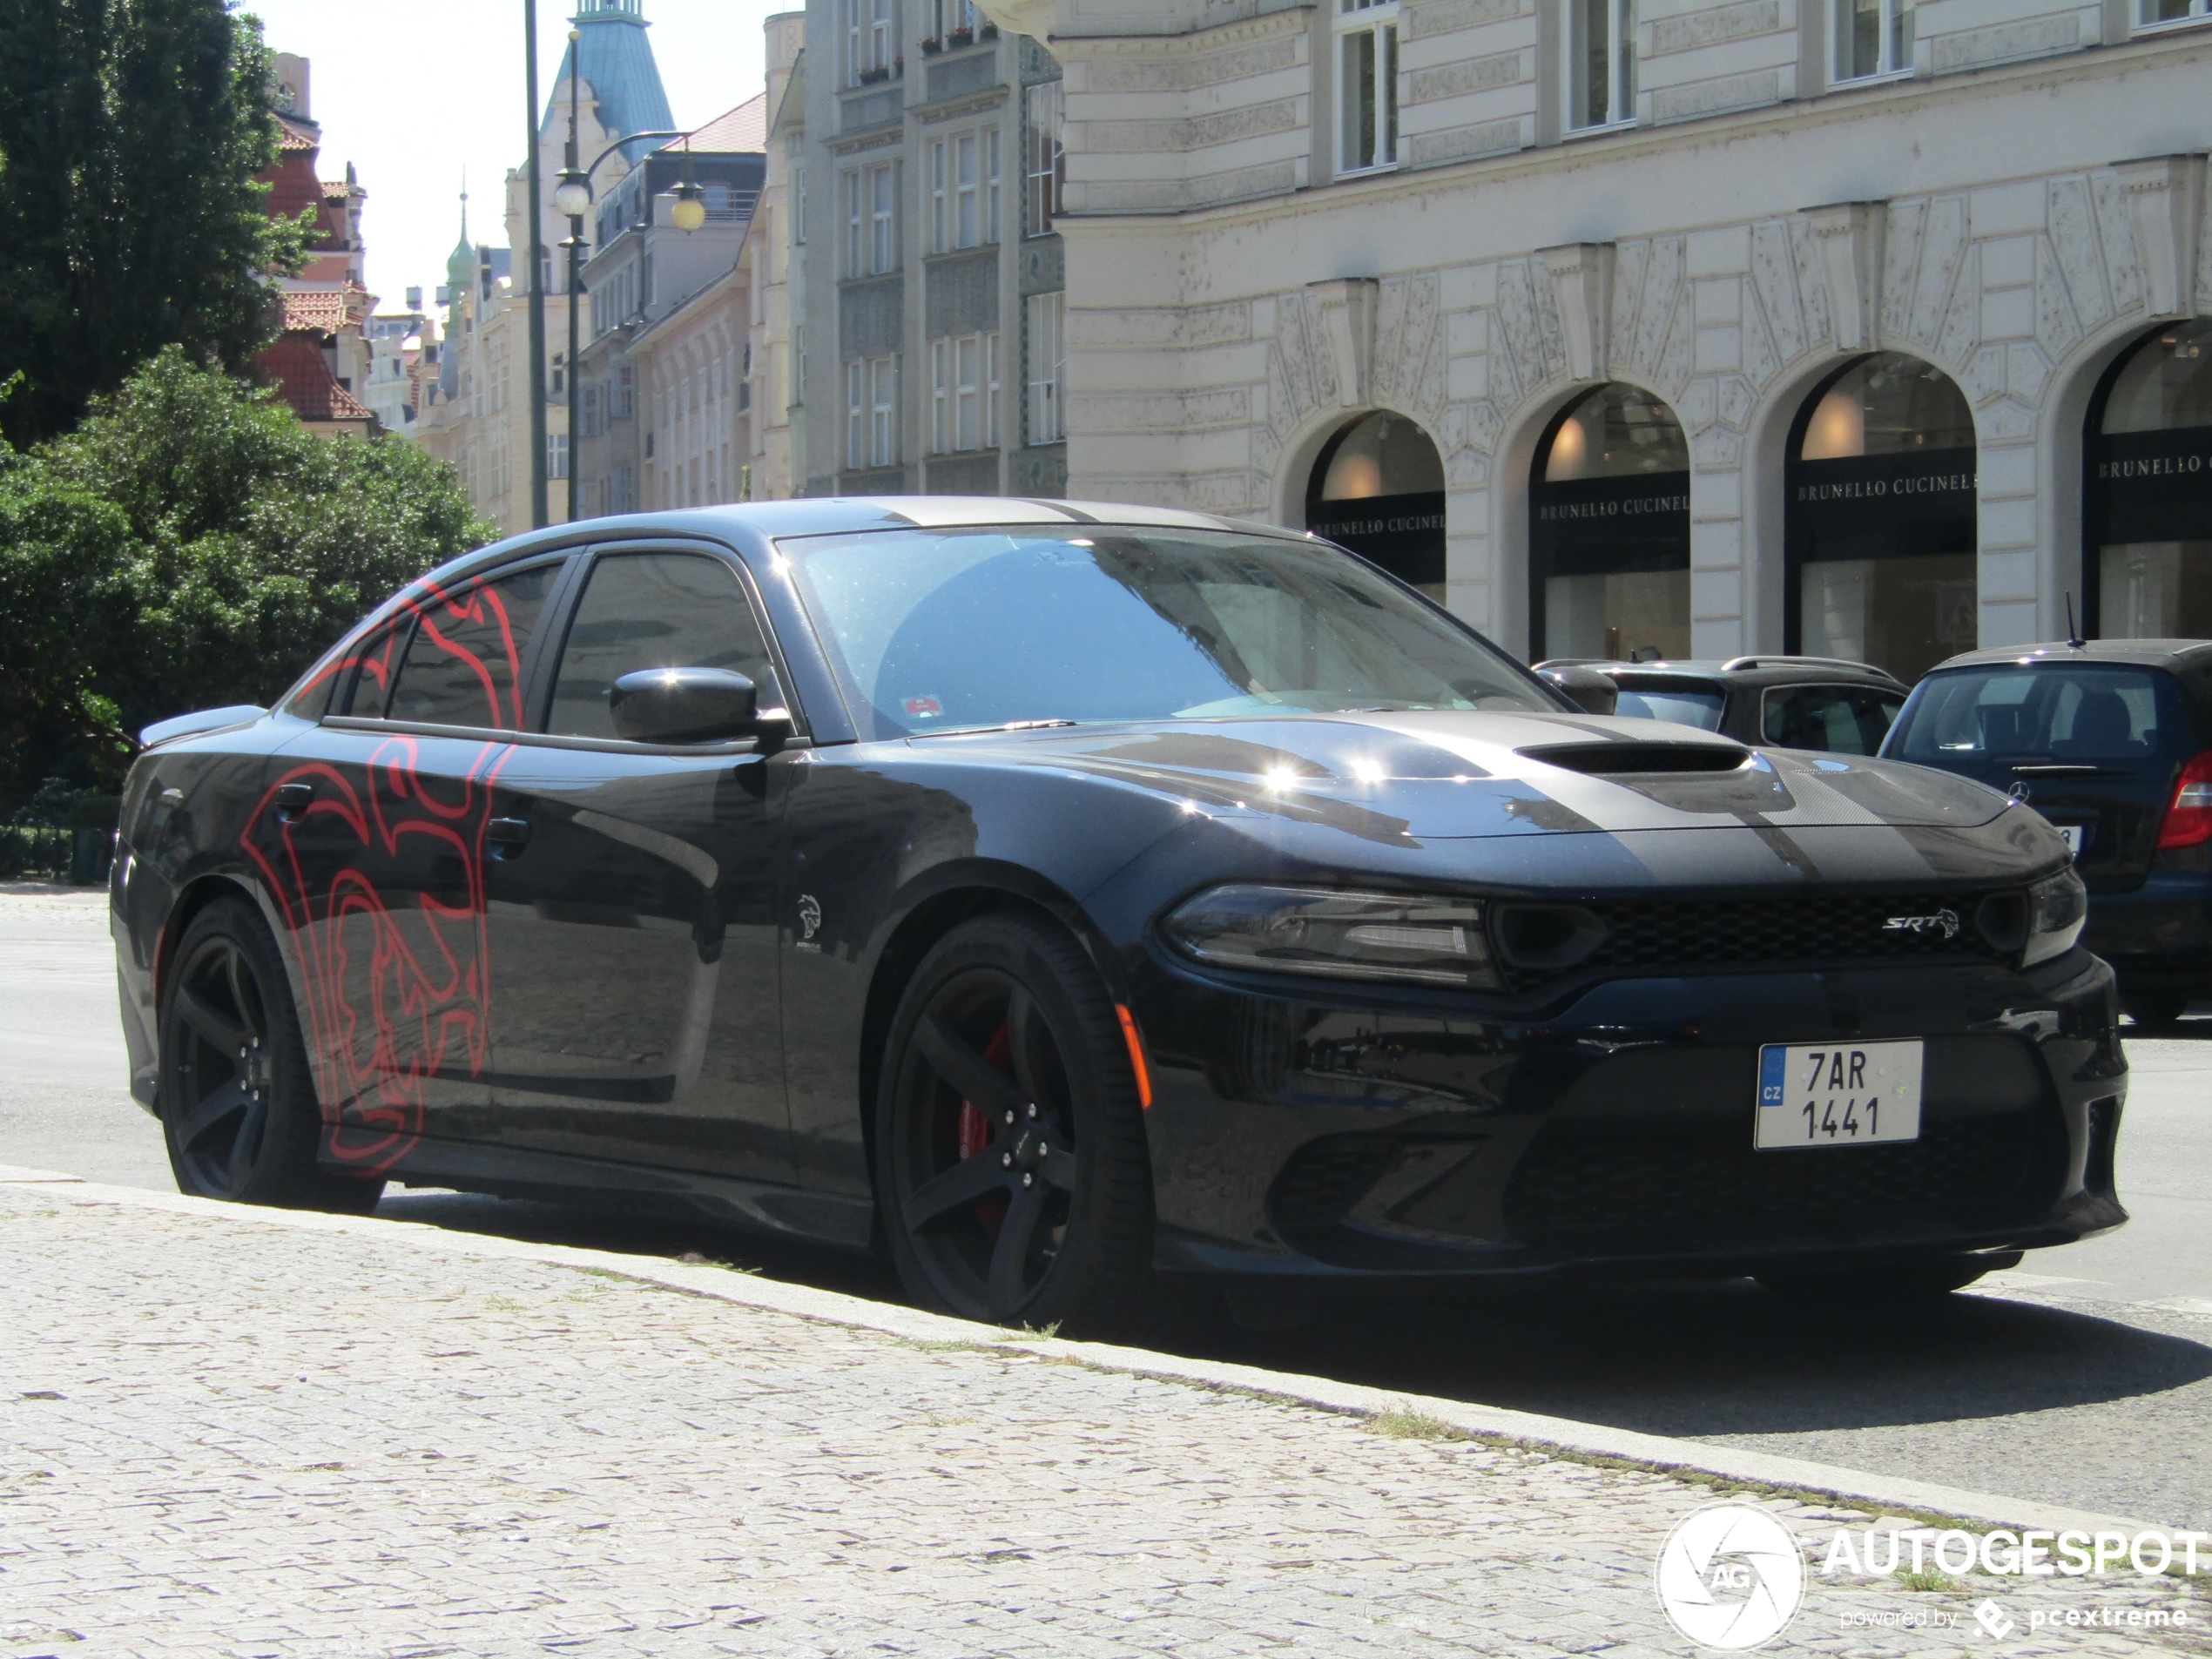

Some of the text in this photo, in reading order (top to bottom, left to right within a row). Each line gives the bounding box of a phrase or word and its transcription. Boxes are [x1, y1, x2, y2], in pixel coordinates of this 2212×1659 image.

[2098, 455, 2202, 479] BRUNELLO
[1797, 480, 1887, 502] BRUNELLO
[1540, 501, 1618, 521] BRUNELLO
[1315, 519, 1384, 536] BRUNELLO
[1882, 916, 1944, 933] SRT
[1806, 1050, 1867, 1092] 7AR
[1763, 1085, 1782, 1101] CZ
[1801, 1096, 1879, 1139] 1441
